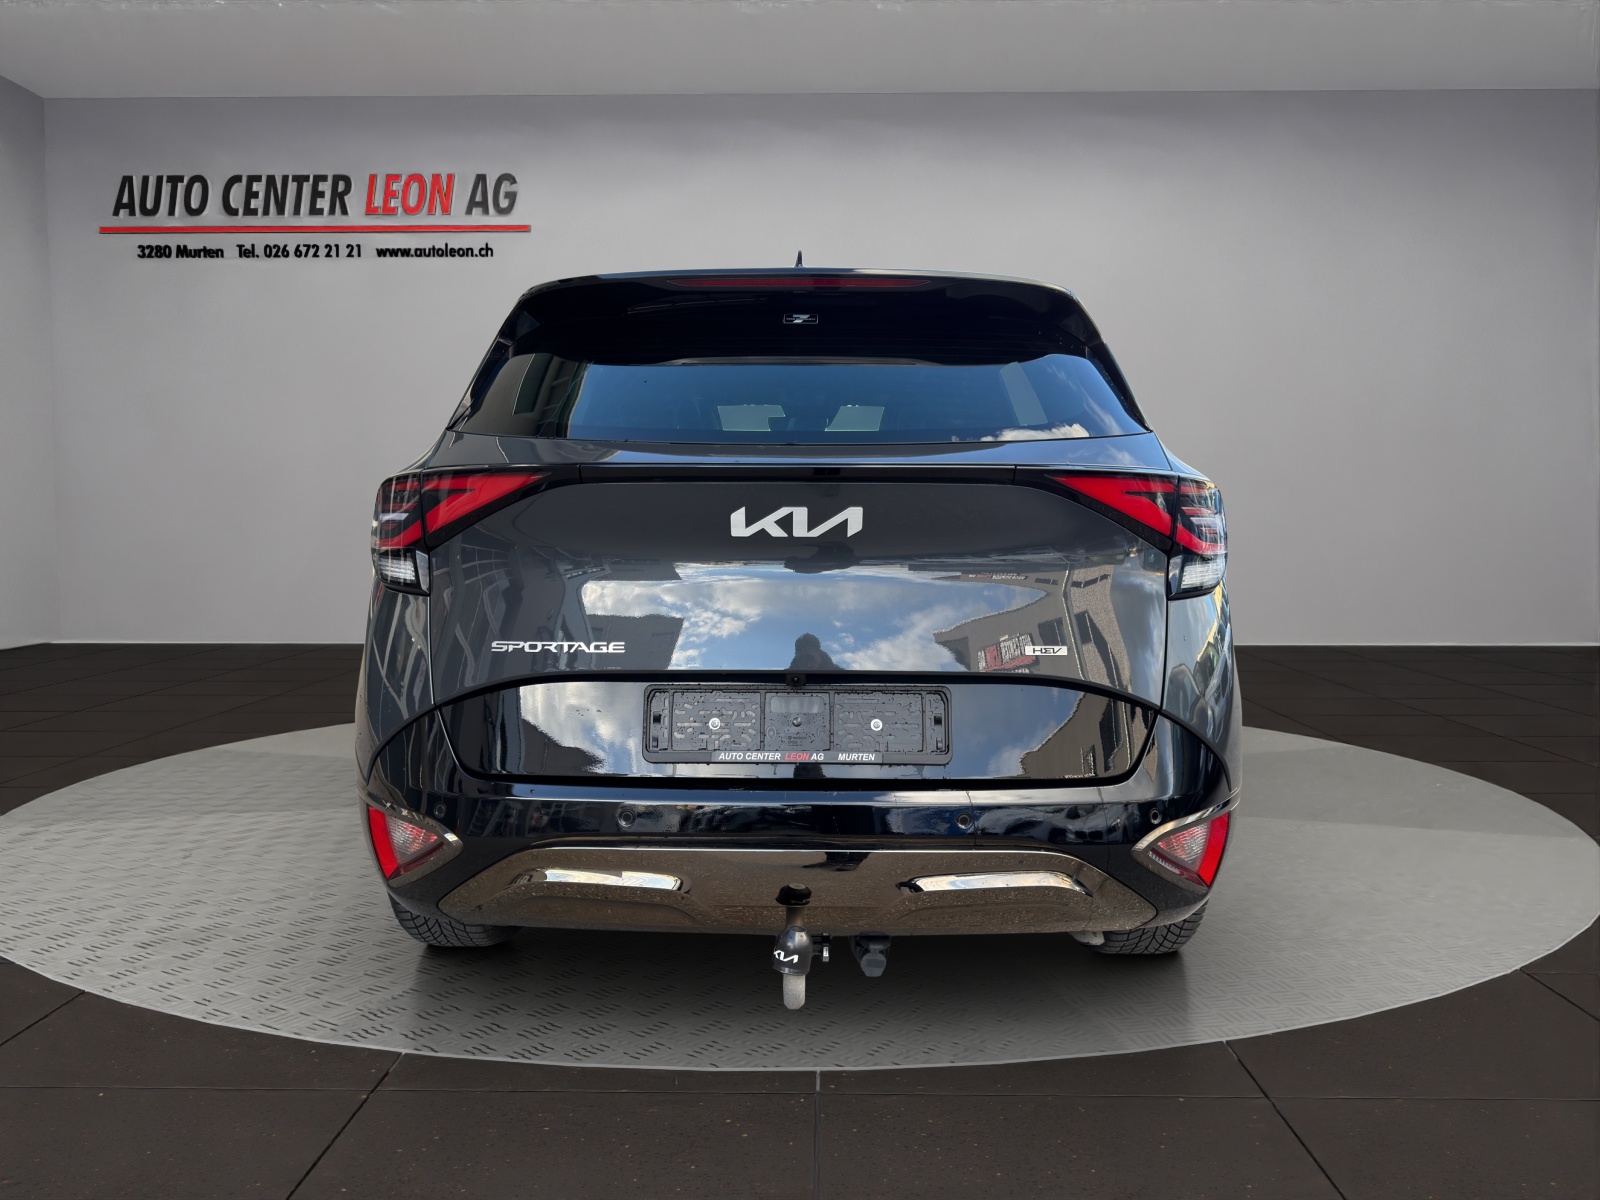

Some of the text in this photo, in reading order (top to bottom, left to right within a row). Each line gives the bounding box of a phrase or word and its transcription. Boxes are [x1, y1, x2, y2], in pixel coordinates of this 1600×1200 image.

[112, 173, 518, 217] AUTO CENTER LEON AG
[136, 242, 494, 259] 3280 Murten Tel. 026 672 21 21 www.autoleon.ch
[730, 506, 864, 538] KIA
[490, 640, 626, 654] SPORTAGE
[718, 752, 876, 762] AUTO CENTER LEON AG MURTEN
